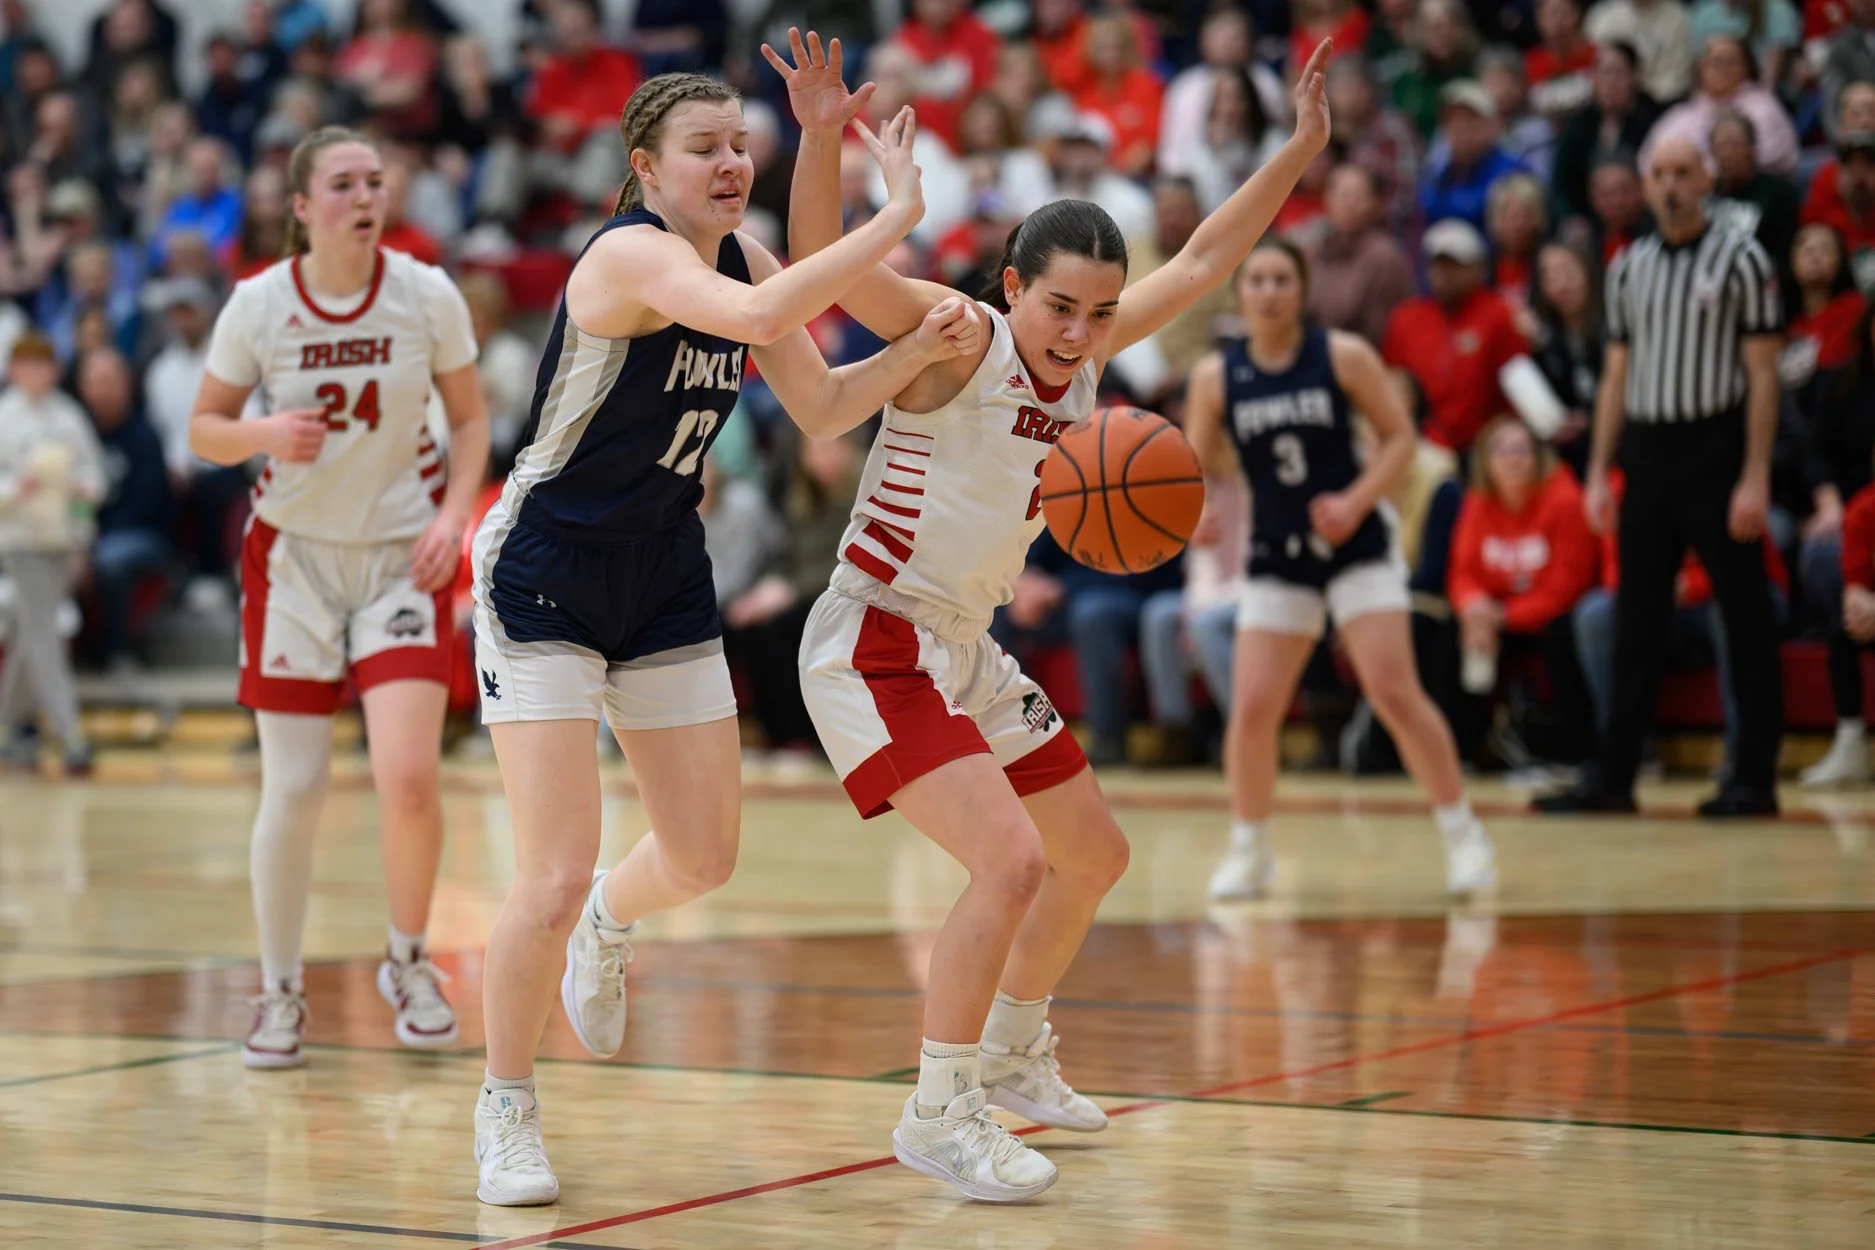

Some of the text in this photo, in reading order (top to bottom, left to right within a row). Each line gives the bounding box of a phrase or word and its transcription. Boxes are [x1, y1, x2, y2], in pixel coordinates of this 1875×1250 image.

[299, 335, 393, 370] IRISH
[664, 339, 744, 392] FOWLE
[315, 378, 382, 432] 24
[1011, 404, 1076, 444] IRI
[656, 409, 720, 477] 12
[1272, 433, 1308, 486] 3
